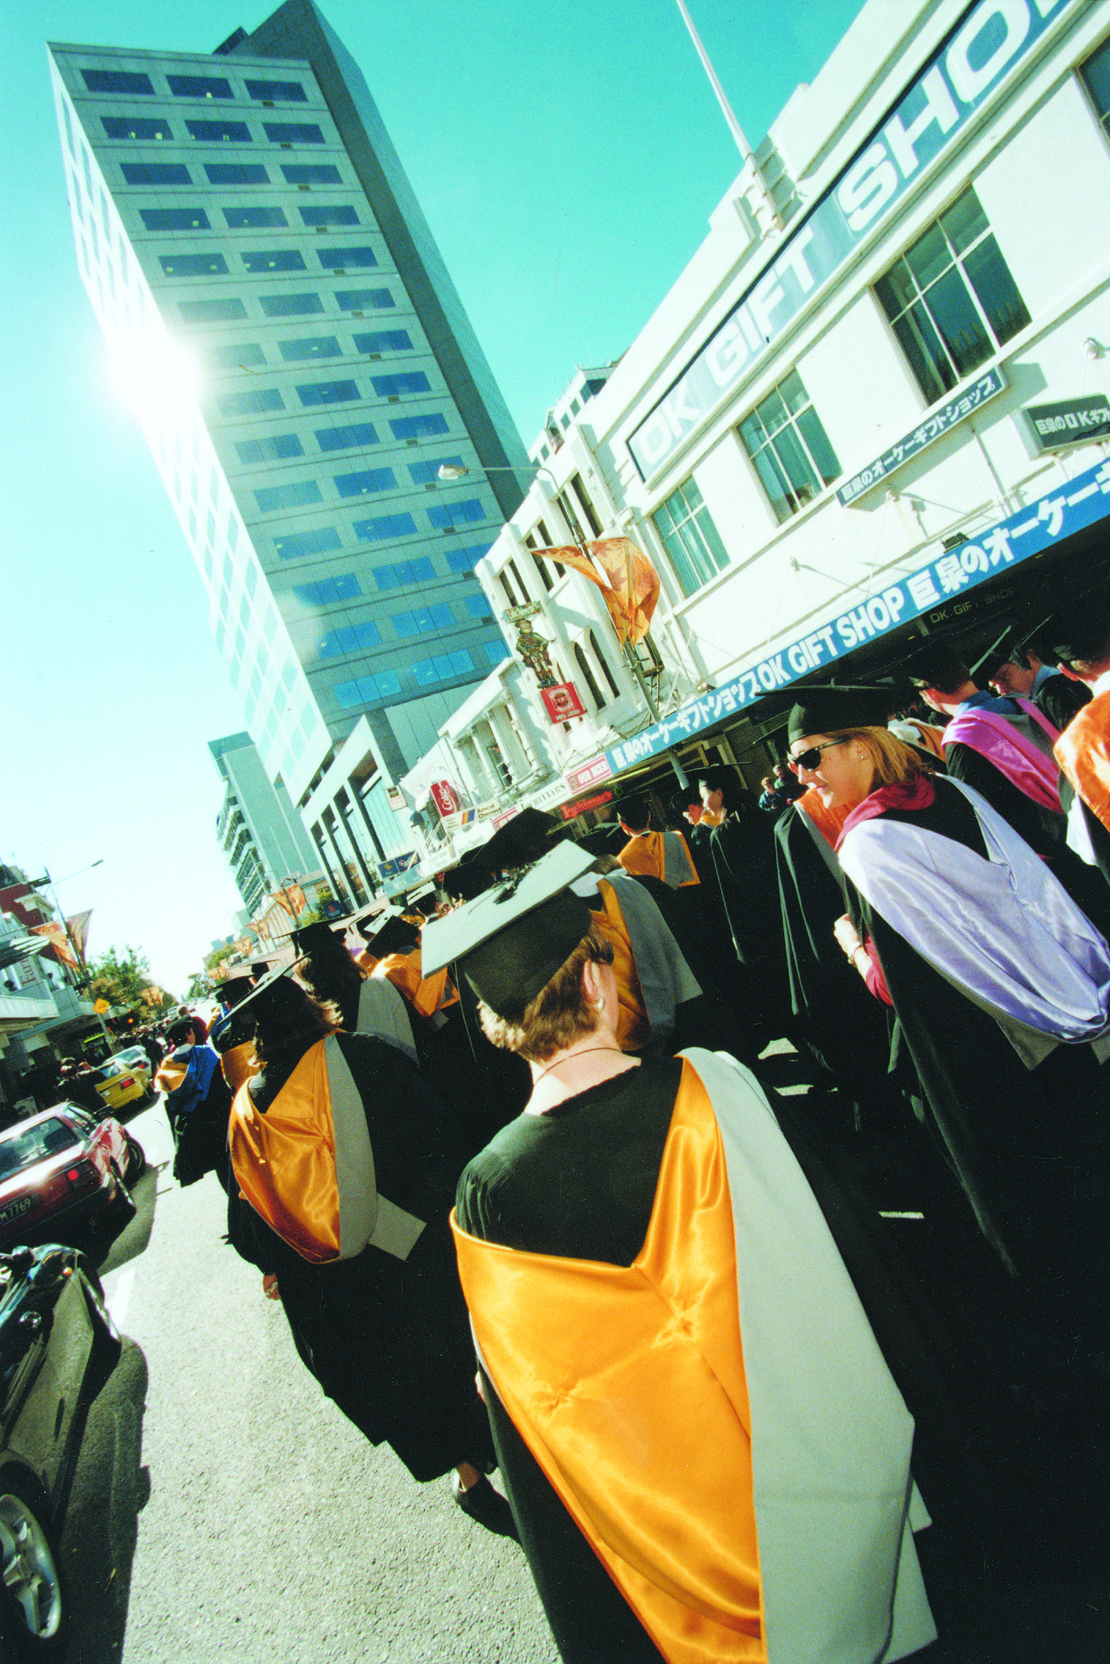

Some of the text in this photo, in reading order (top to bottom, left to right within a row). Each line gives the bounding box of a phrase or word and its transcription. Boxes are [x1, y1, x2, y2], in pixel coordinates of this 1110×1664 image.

[637, 0, 1061, 466] OK GIFT SHO
[757, 654, 791, 690] OK
[787, 625, 838, 674] GIFT
[836, 586, 905, 648] SHOP
[930, 609, 950, 623] OK
